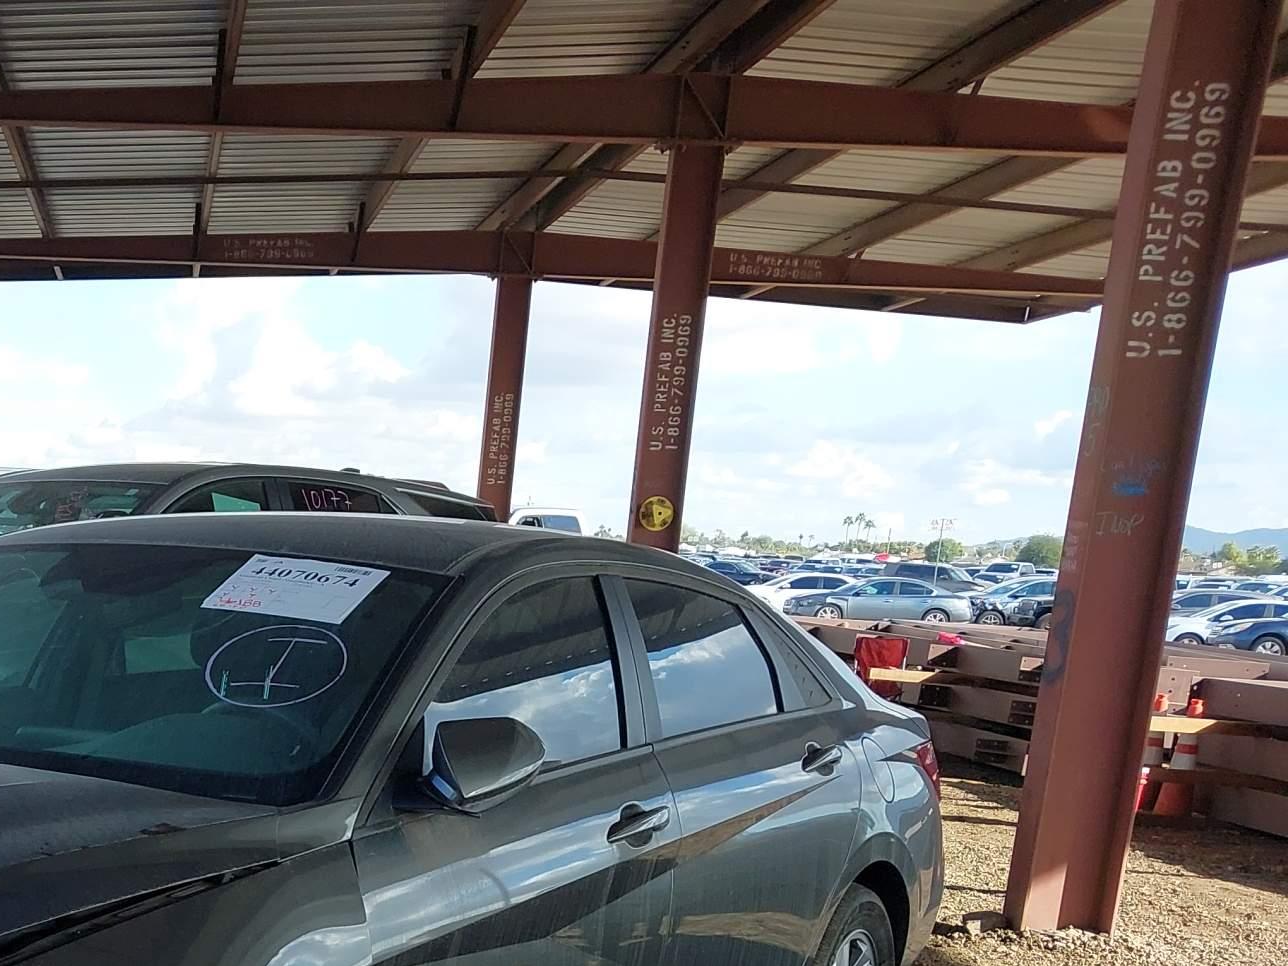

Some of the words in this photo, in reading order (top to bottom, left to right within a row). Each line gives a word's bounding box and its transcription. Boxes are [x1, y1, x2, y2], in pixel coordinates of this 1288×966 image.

[1163, 80, 1200, 141] INC.
[1139, 160, 1183, 281] PREFAB
[1158, 83, 1230, 356] 1-866-799-0969
[660, 312, 678, 343] INC.
[1126, 302, 1158, 358] U.S.
[653, 351, 672, 412] PREFAB
[665, 315, 692, 449] 1-866-799-0969
[489, 417, 502, 459] PREFAB
[649, 421, 665, 451] U.S.
[301, 488, 352, 511] 10177
[252, 566, 361, 588] 44070674
